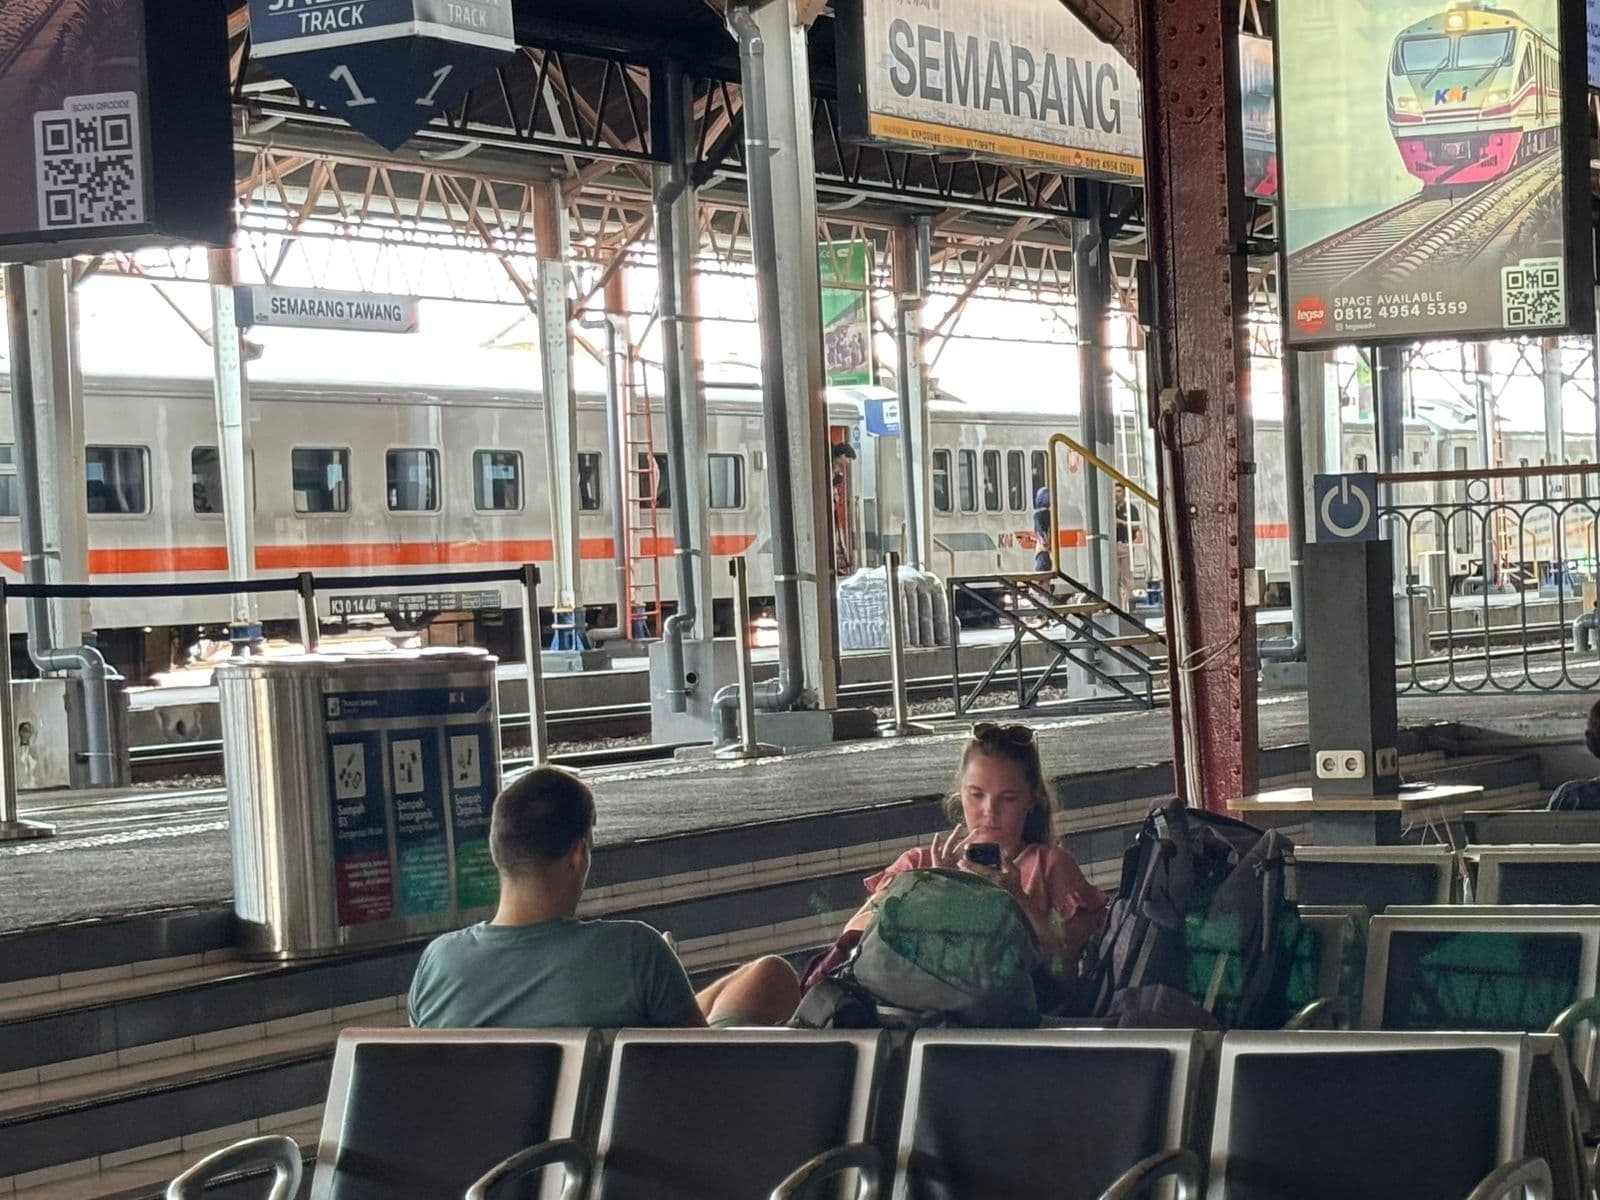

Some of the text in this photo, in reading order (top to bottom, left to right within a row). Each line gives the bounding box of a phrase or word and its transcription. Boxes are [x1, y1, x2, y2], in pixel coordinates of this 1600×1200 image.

[298, 4, 364, 33] TRACK
[447, 3, 487, 28] TRACK
[329, 64, 376, 107] 1
[415, 64, 453, 107] 1
[888, 18, 1121, 134] SEMARANG
[271, 297, 344, 318] SEMARANG
[346, 301, 402, 322] TAWANG
[1333, 301, 1468, 321] 0812 4954 5359
[1334, 291, 1443, 307] SPACE AVAILABLE
[331, 600, 344, 614] K3
[353, 599, 364, 613] 14
